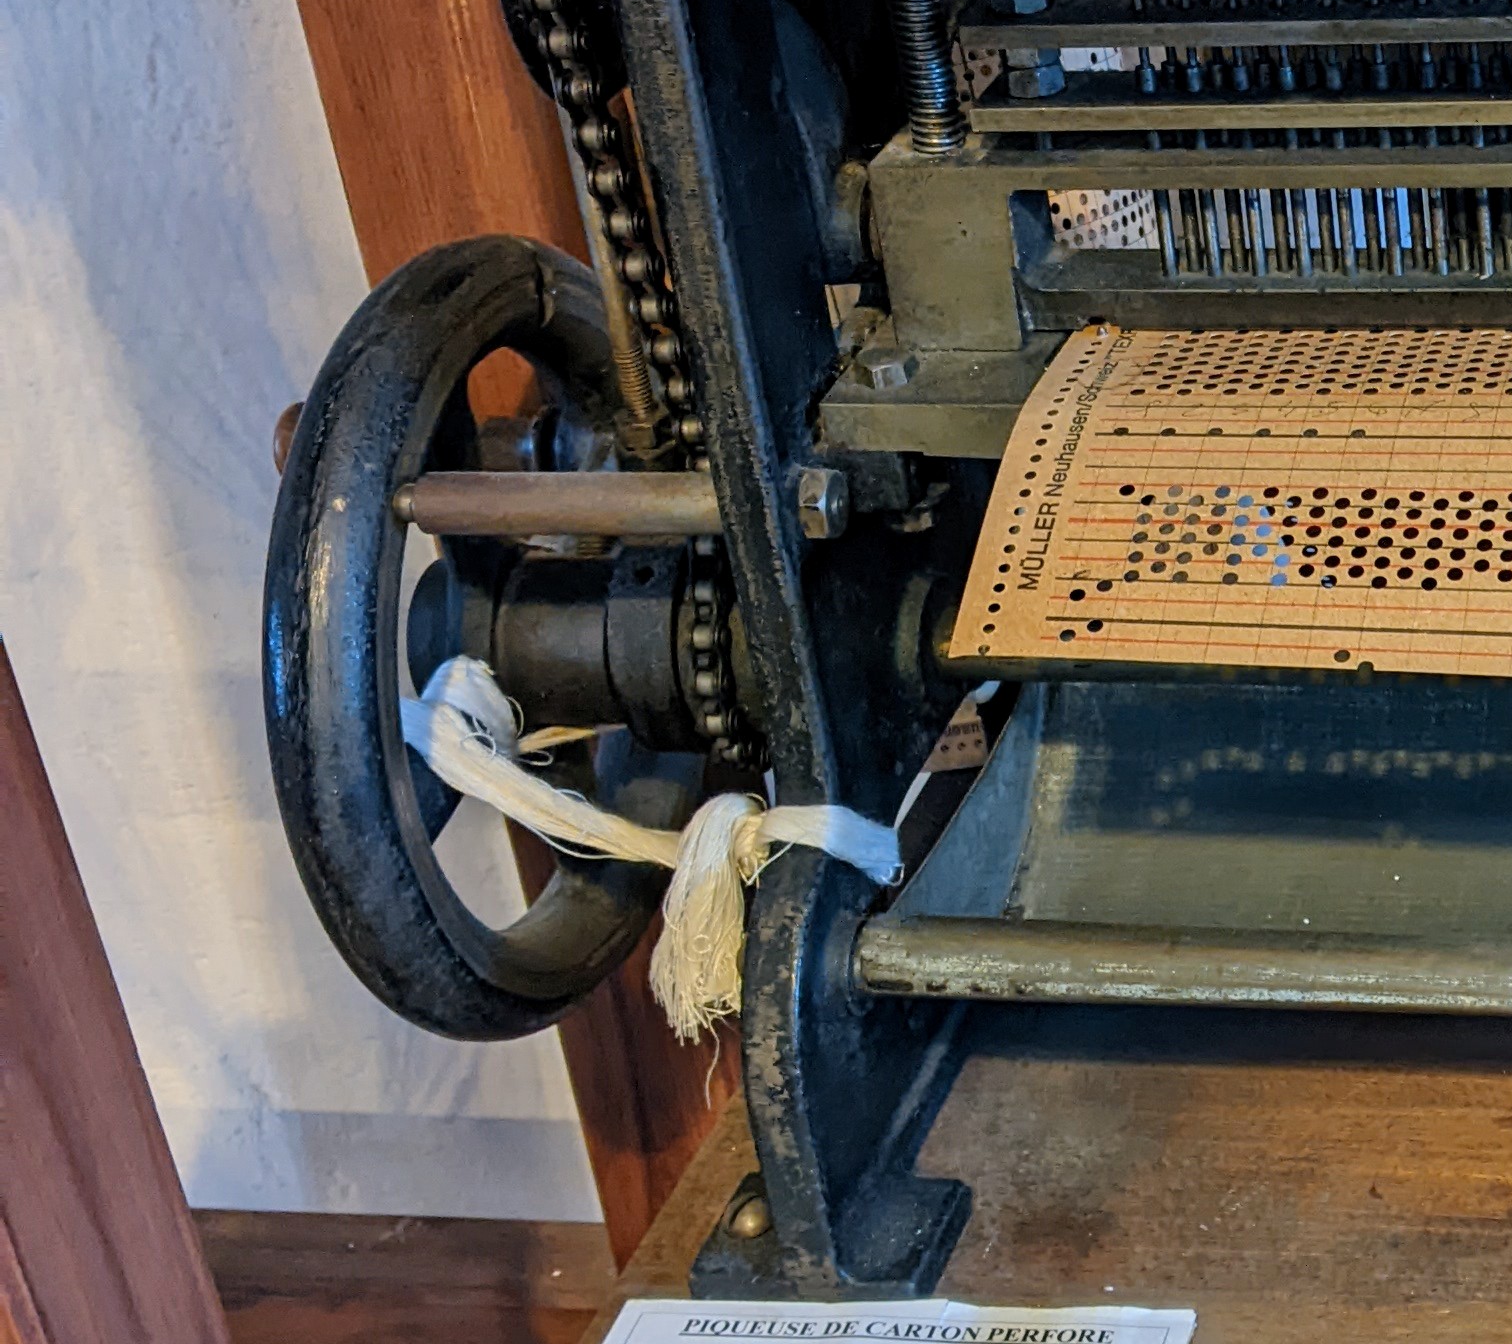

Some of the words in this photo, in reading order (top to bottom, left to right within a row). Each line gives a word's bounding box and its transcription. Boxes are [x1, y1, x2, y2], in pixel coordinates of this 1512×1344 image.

[1017, 503, 1061, 591] MÜLLER
[682, 1318, 818, 1337] PIQUEUSE
[823, 1320, 859, 1336] DE
[865, 1321, 982, 1341] CARTON
[986, 1327, 1115, 1344] PERFORE
